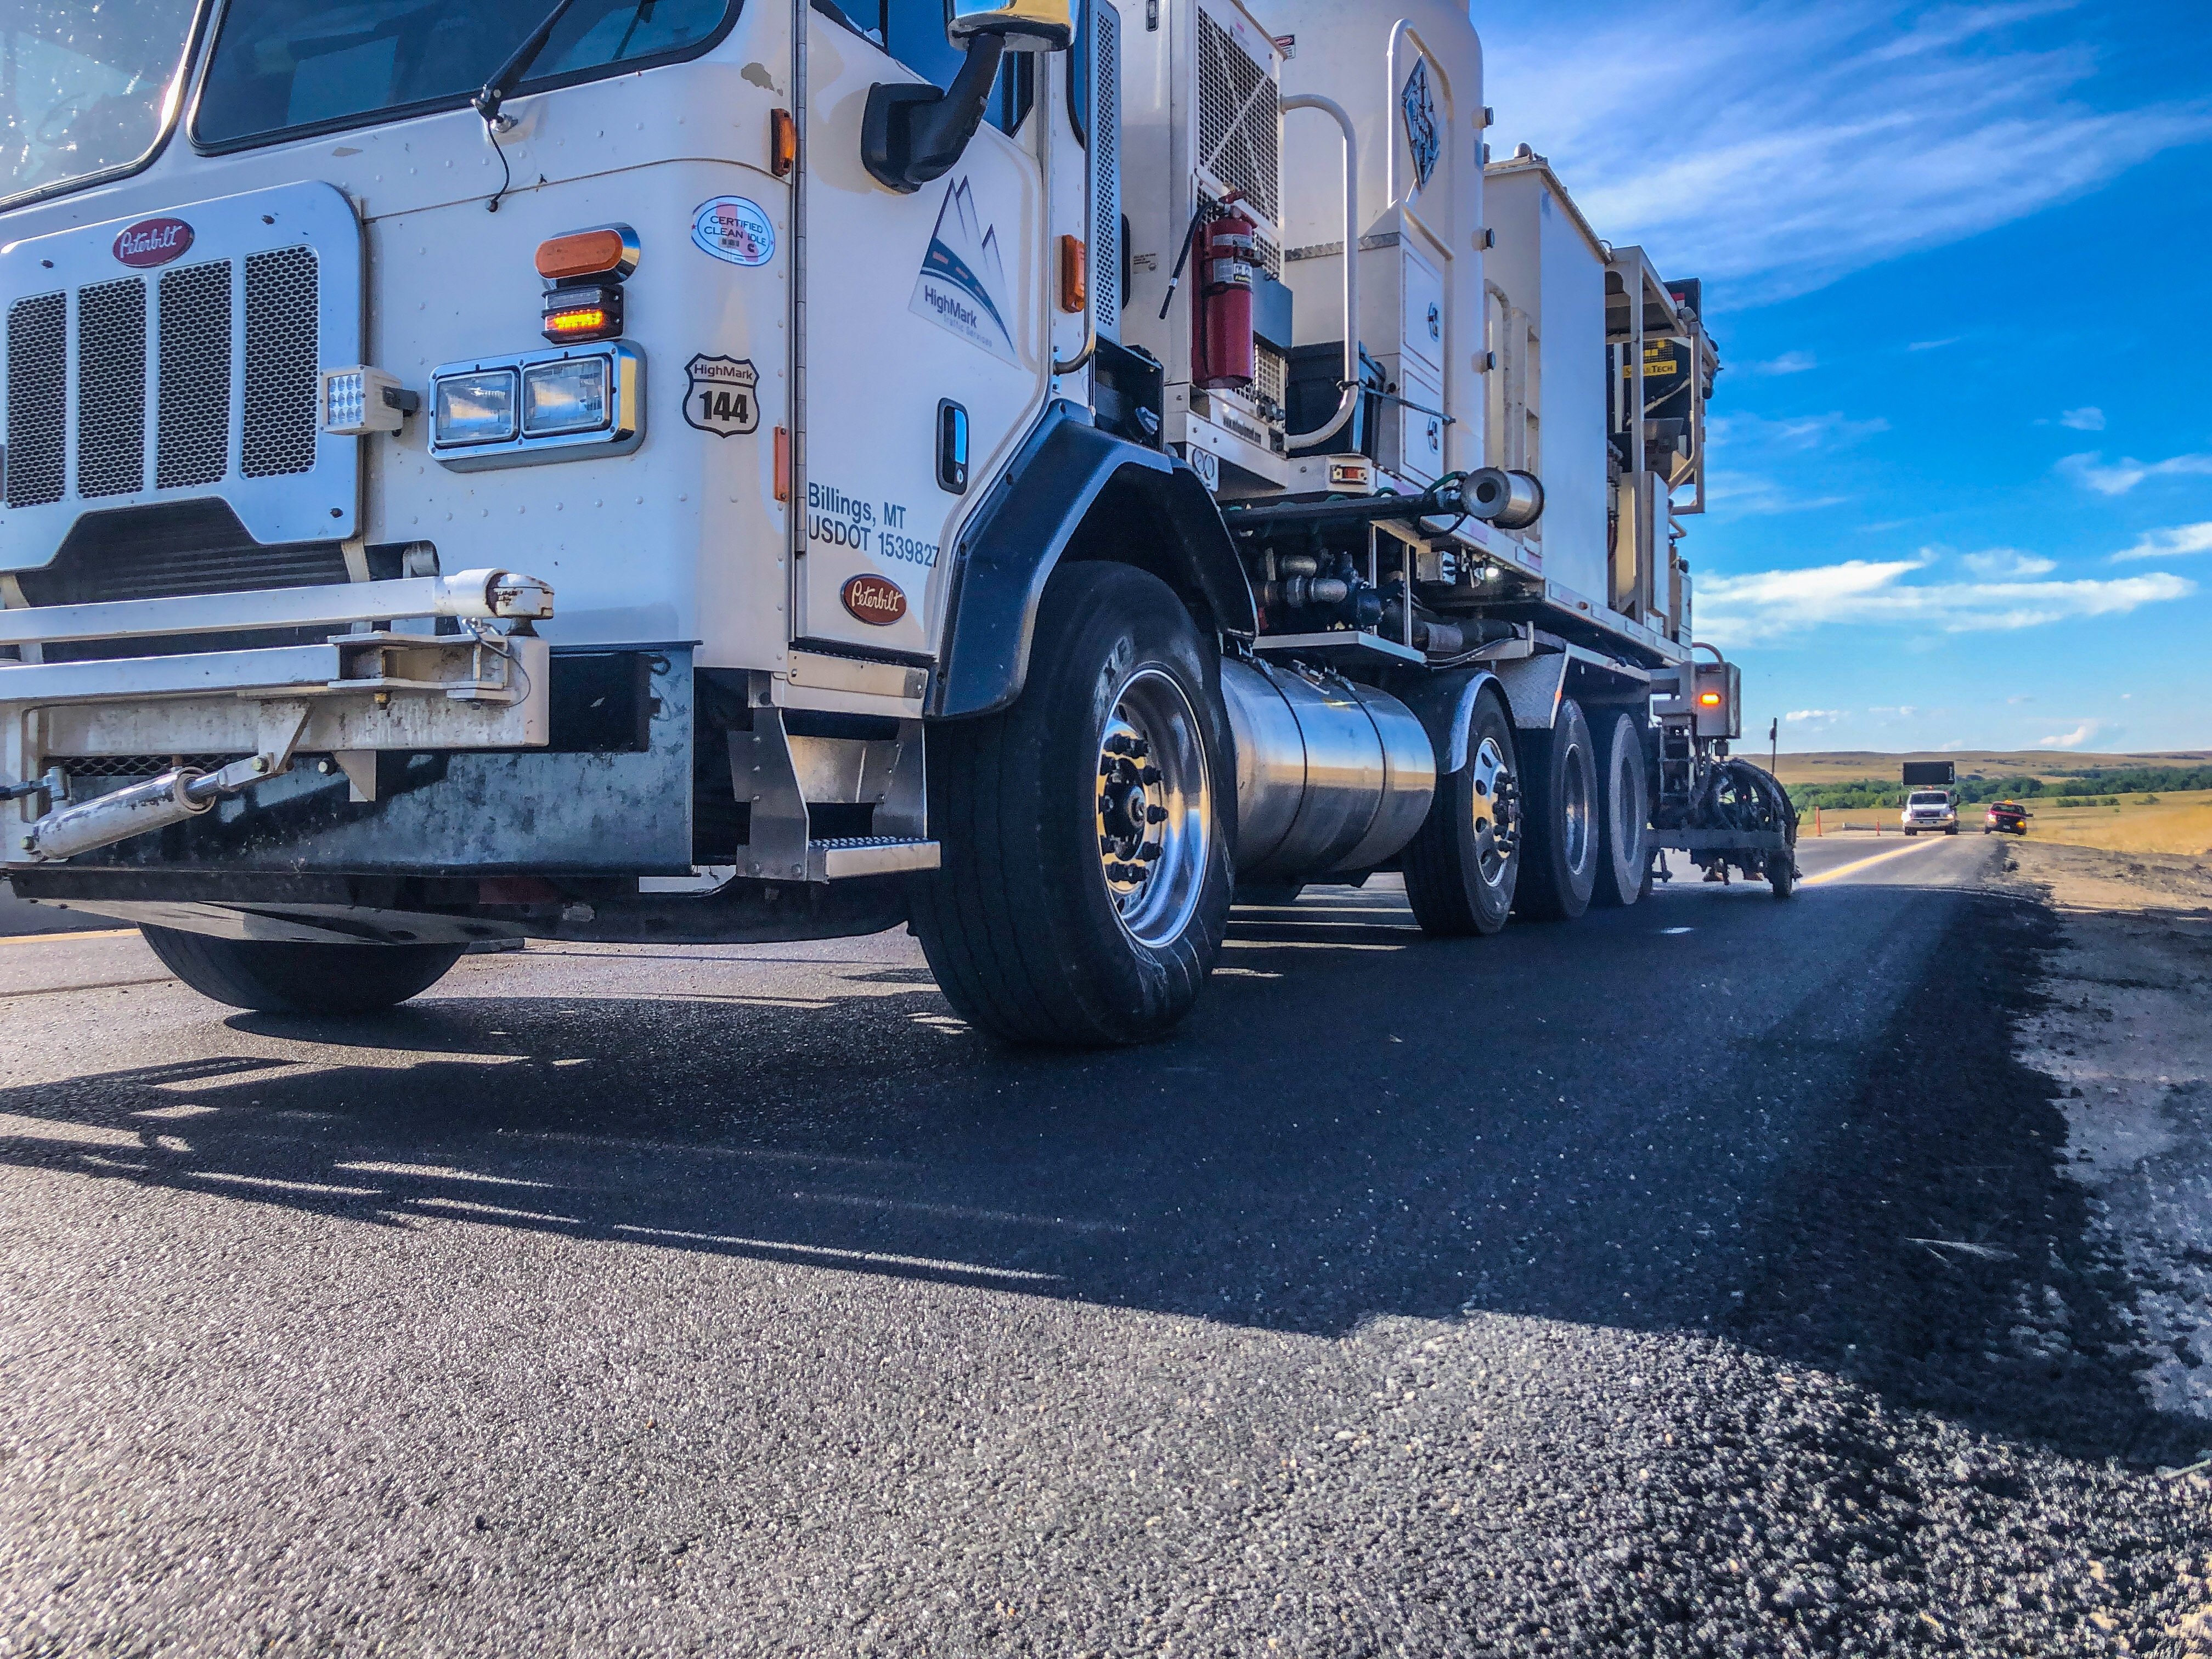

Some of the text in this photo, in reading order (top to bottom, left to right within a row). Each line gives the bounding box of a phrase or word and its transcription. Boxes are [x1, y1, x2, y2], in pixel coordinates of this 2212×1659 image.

[704, 226, 743, 239] CLEAN
[748, 233, 766, 246] IDLE
[710, 215, 763, 234] CERTIFIED
[120, 225, 183, 258] Peterbilt
[925, 285, 977, 328] HighMark
[694, 364, 752, 380] HighMark
[699, 390, 748, 424] 144
[809, 482, 906, 529] Billings, MT
[808, 514, 940, 568] USDOT 1539827
[851, 580, 902, 612] Peterbilt
